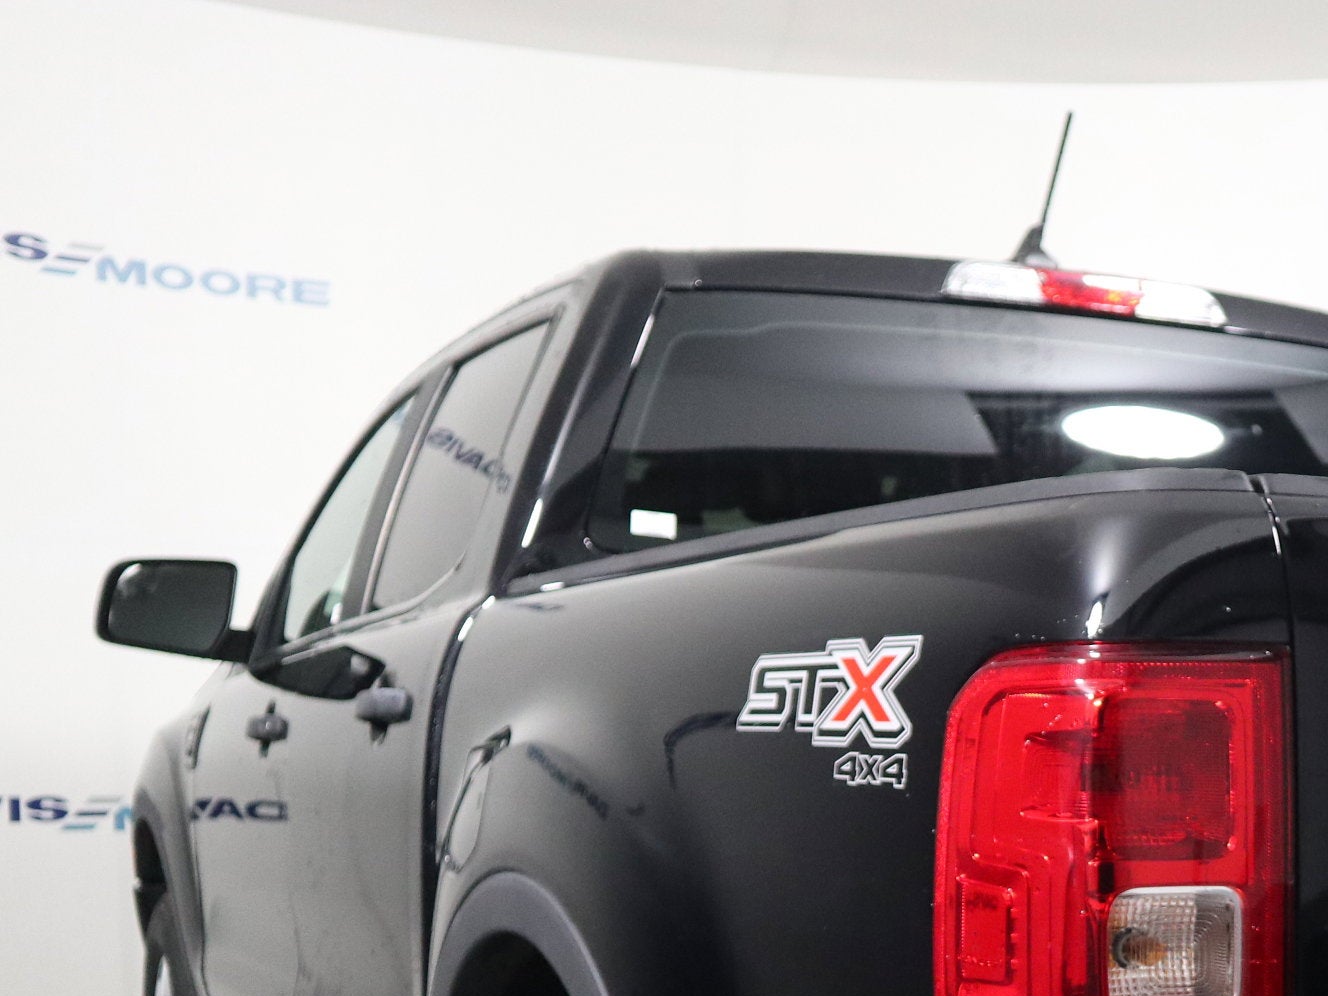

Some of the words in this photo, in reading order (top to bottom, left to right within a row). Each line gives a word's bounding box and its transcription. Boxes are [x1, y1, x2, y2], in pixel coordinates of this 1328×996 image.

[96, 255, 331, 307] MOORE
[736, 634, 924, 749] STX
[0, 794, 69, 822] IS
